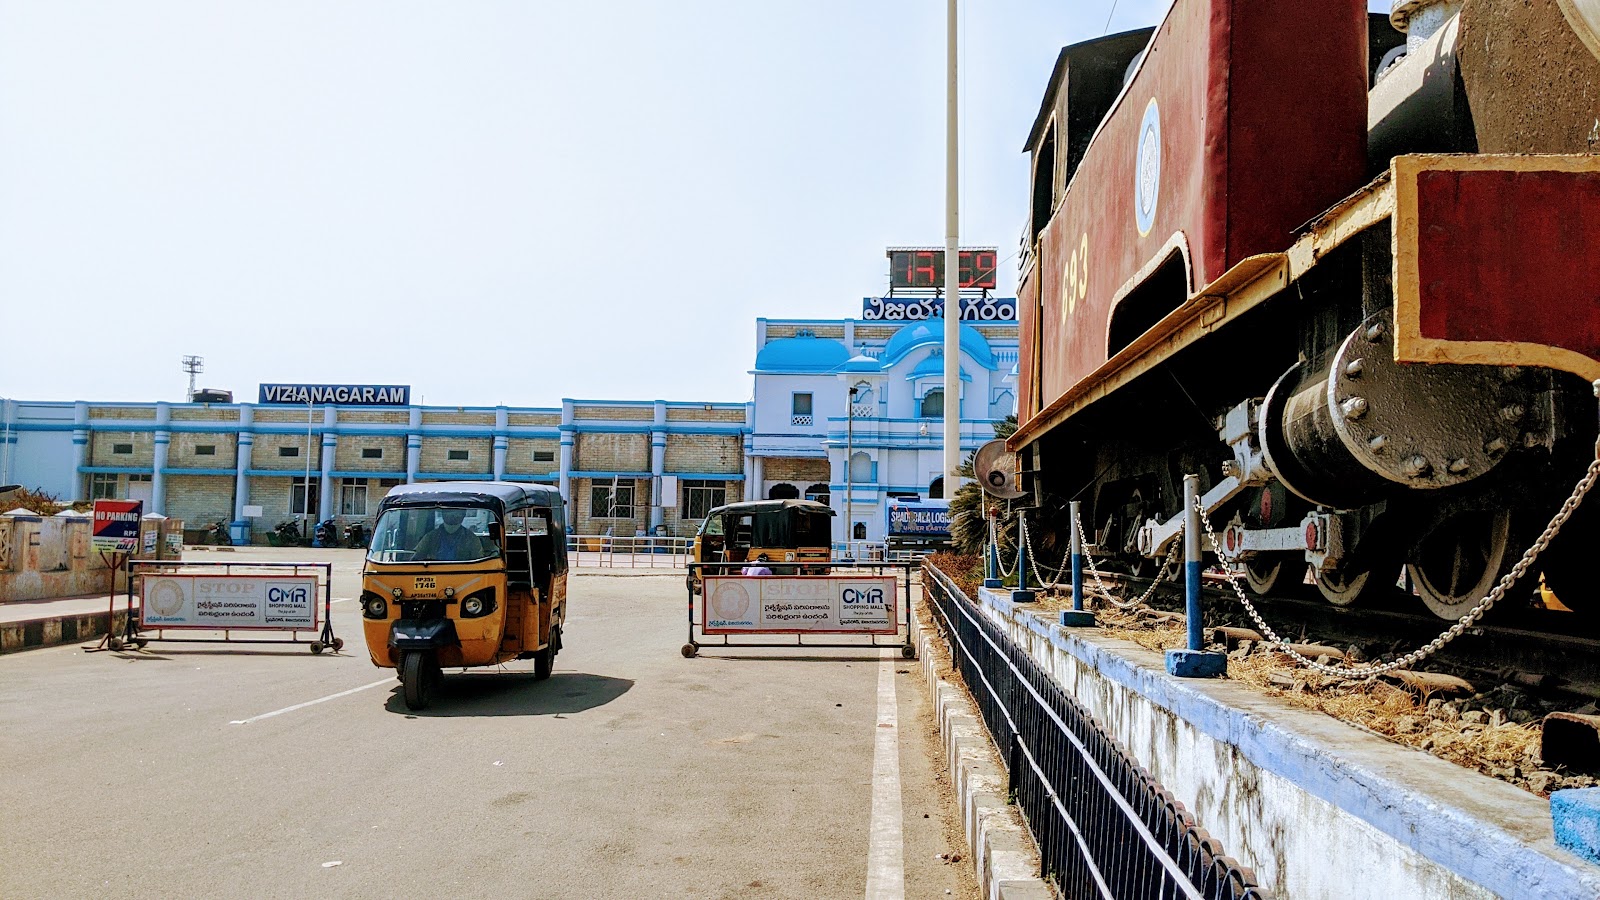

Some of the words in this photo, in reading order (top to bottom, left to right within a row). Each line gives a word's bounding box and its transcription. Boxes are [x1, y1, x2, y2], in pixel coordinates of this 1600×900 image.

[1062, 232, 1088, 326] 693
[863, 296, 1015, 321] విజయగరం
[264, 385, 404, 403] VIZIANAGARAM
[96, 511, 105, 521] NO
[107, 512, 138, 522] PARKING
[200, 583, 255, 594] STOP
[268, 586, 307, 603] CMR
[842, 586, 884, 604] CMR
